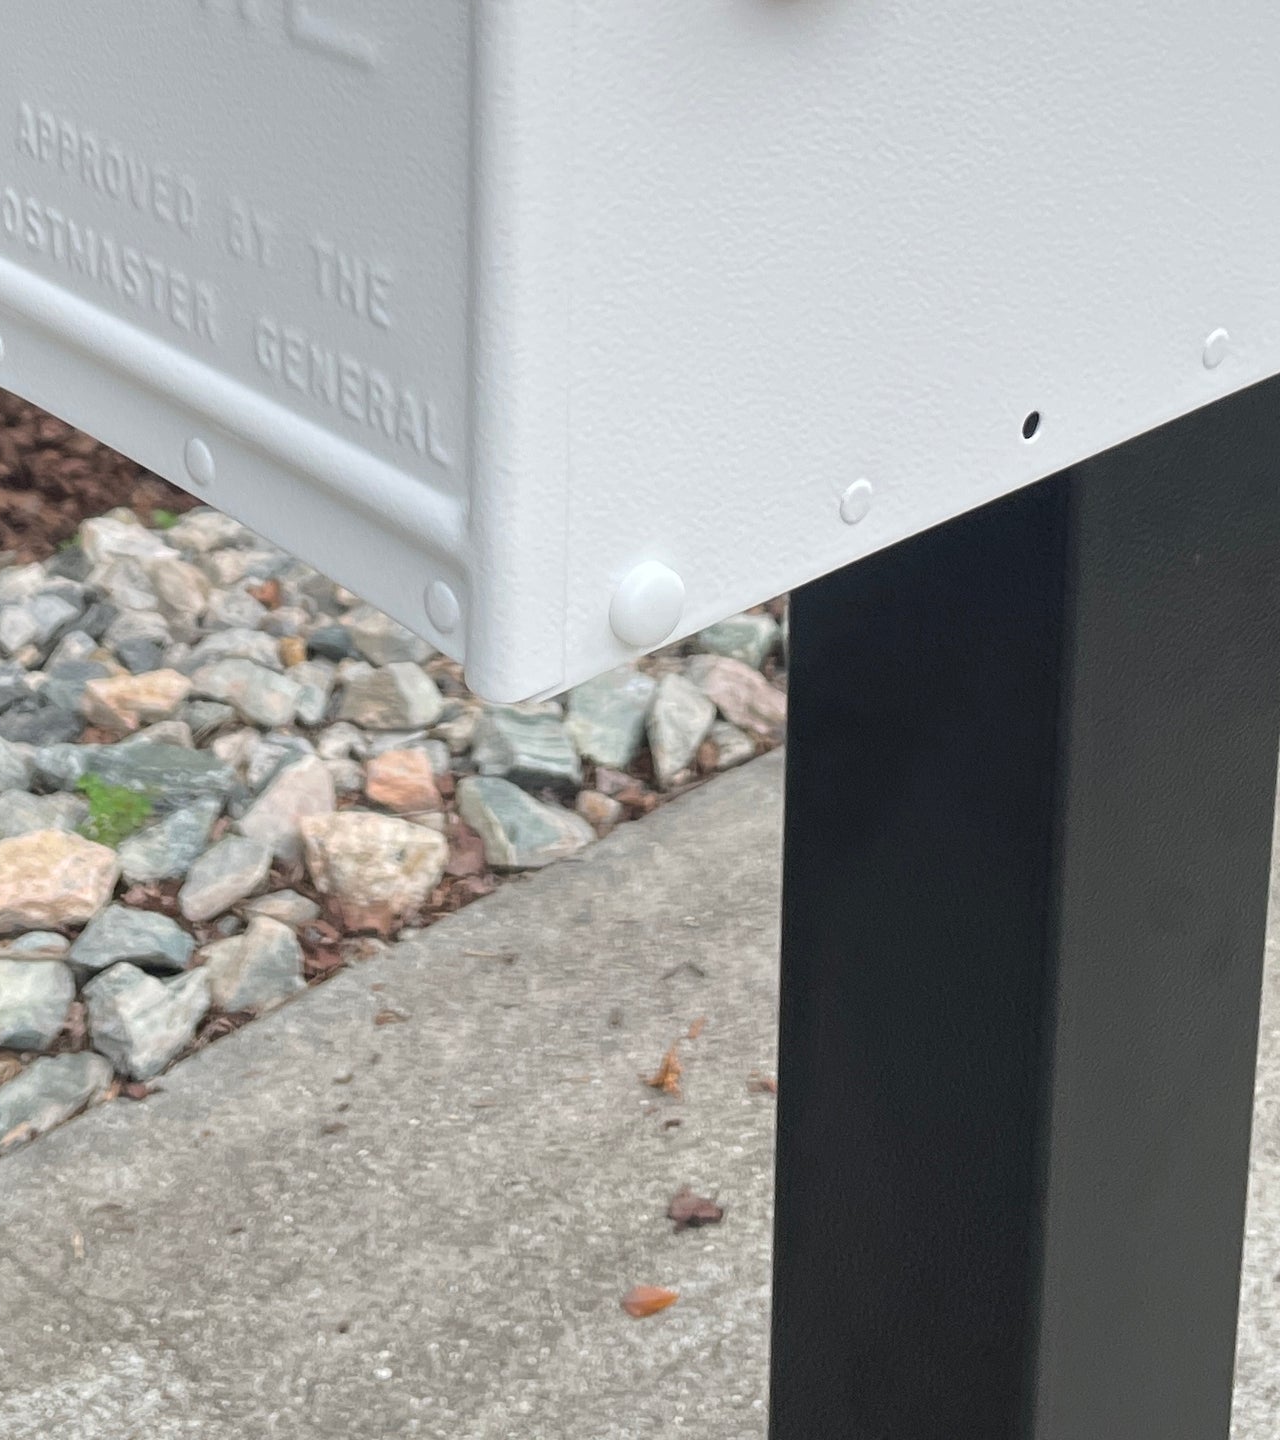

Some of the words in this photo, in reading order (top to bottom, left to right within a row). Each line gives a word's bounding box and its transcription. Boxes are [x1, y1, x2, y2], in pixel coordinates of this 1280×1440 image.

[18, 101, 199, 235] APPROVED
[227, 194, 276, 266] BY
[311, 236, 392, 330] THE
[254, 316, 450, 472] GENERAL
